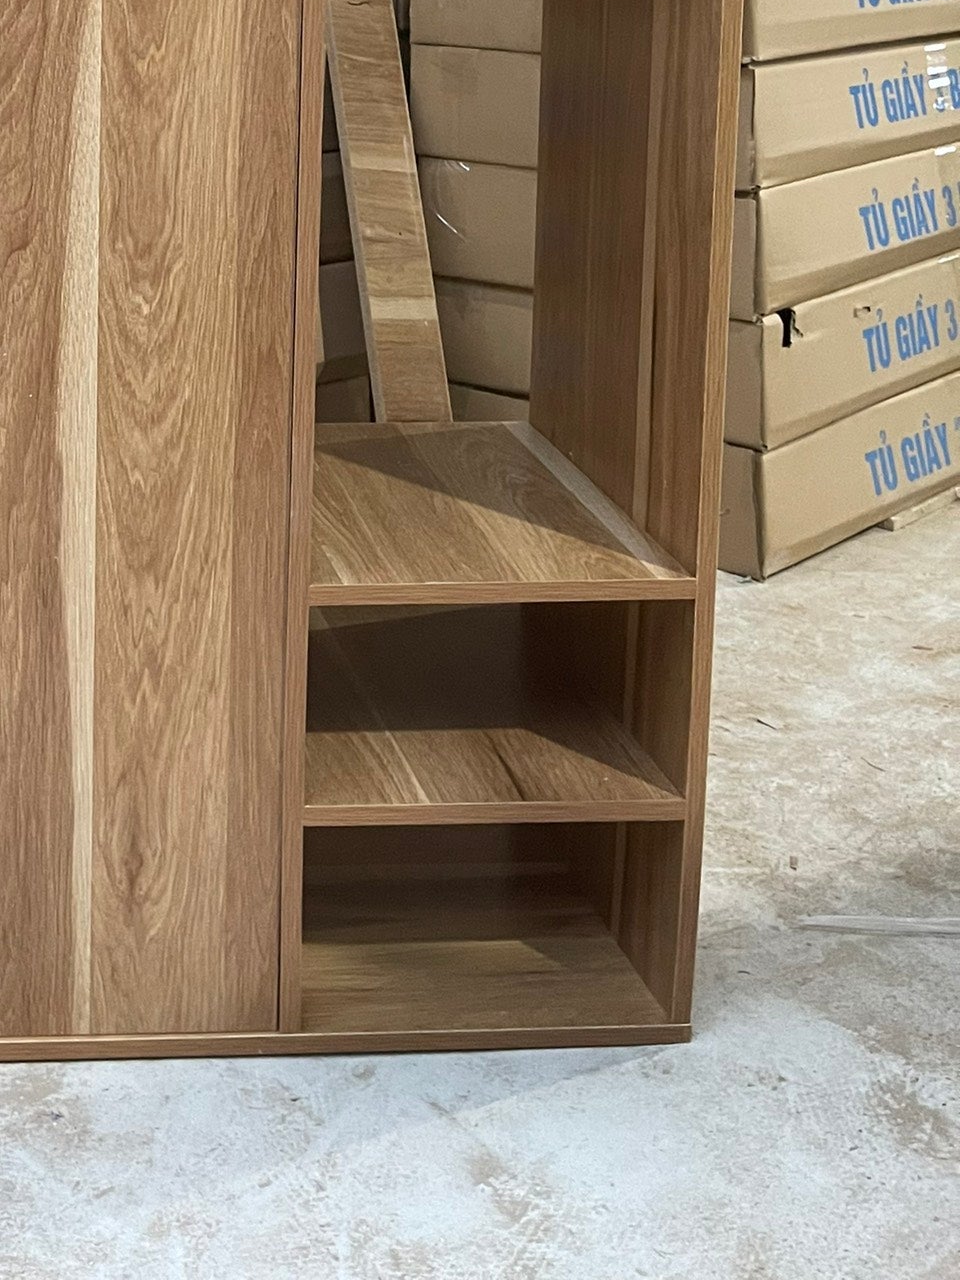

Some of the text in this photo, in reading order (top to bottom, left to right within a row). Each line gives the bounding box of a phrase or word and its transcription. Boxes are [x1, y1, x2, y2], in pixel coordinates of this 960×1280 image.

[849, 68, 879, 129] TỦ
[859, 188, 890, 251] TỦ
[862, 308, 891, 373] TỦ
[865, 430, 898, 497] TỦ
